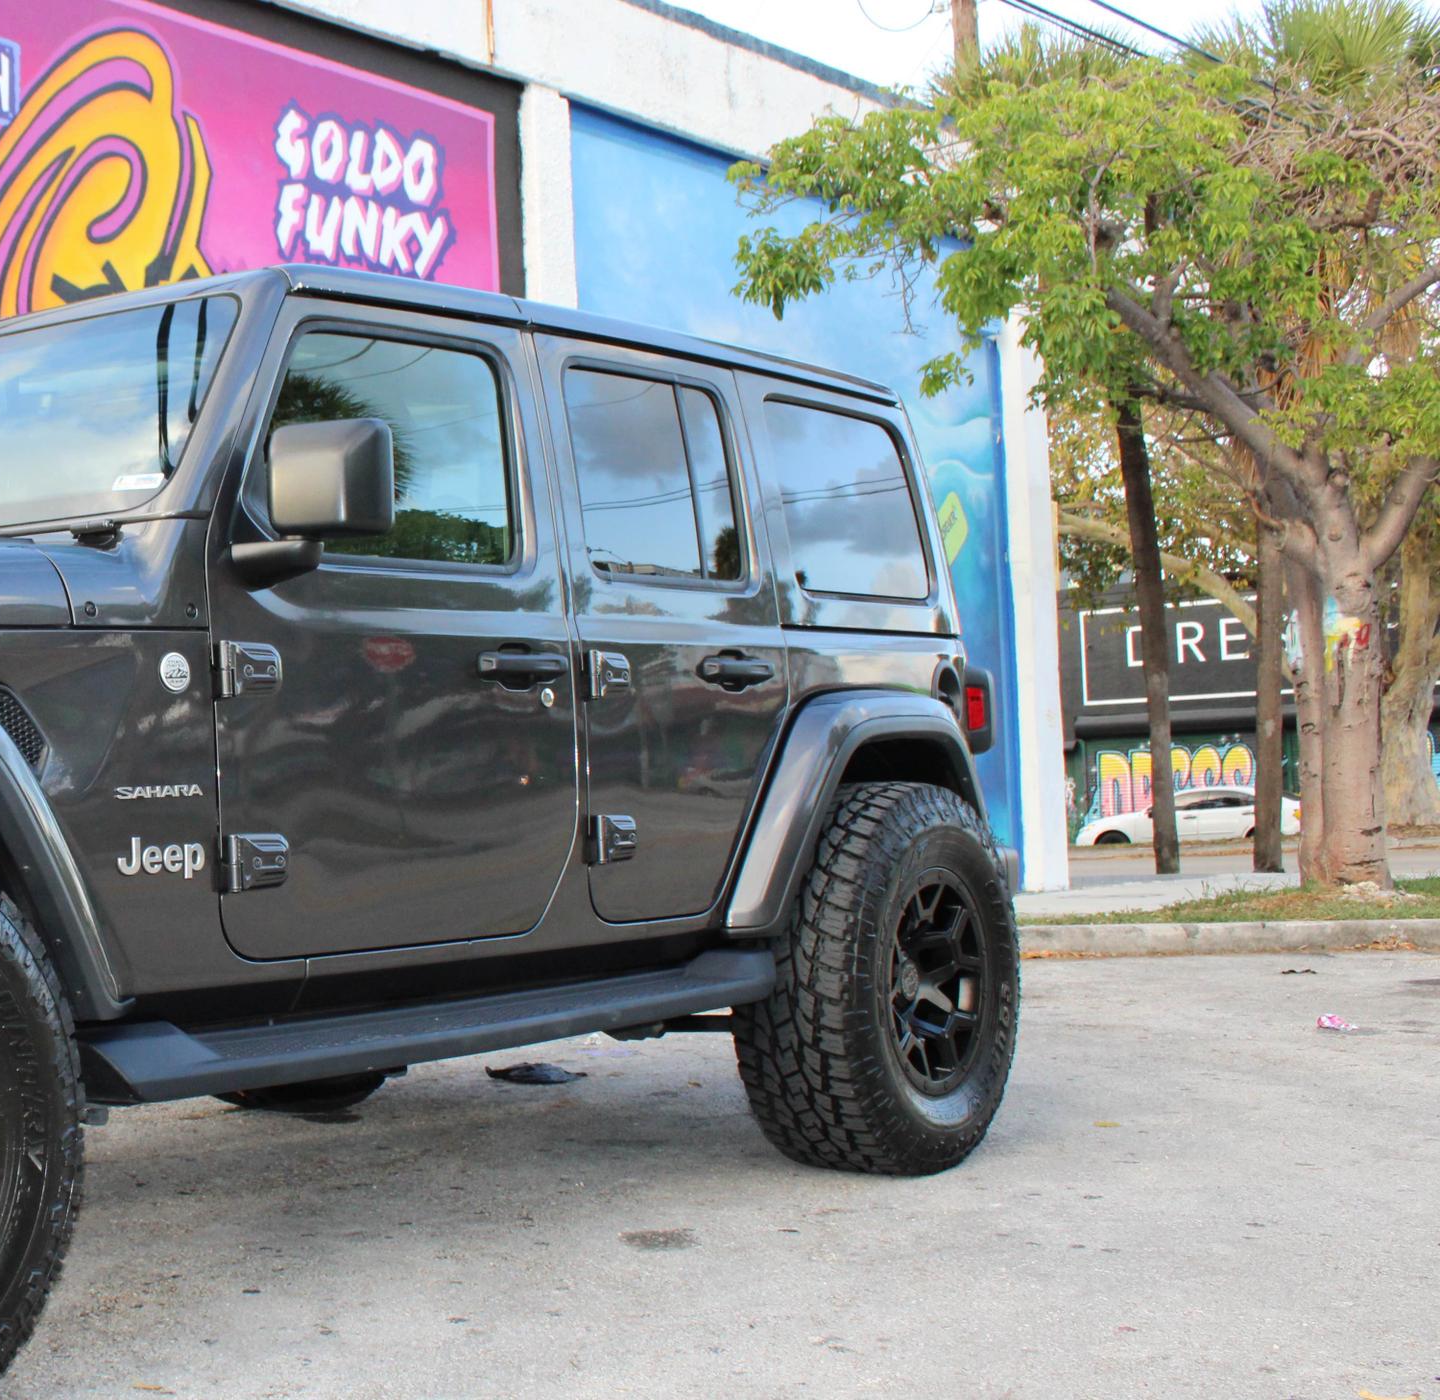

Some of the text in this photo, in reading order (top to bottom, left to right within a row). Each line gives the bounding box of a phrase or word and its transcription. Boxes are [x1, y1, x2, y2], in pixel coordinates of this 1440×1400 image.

[275, 109, 437, 207] GOLDO
[277, 183, 449, 280] FUNKY
[114, 783, 204, 800] SAHARA
[117, 836, 206, 880] Jeep
